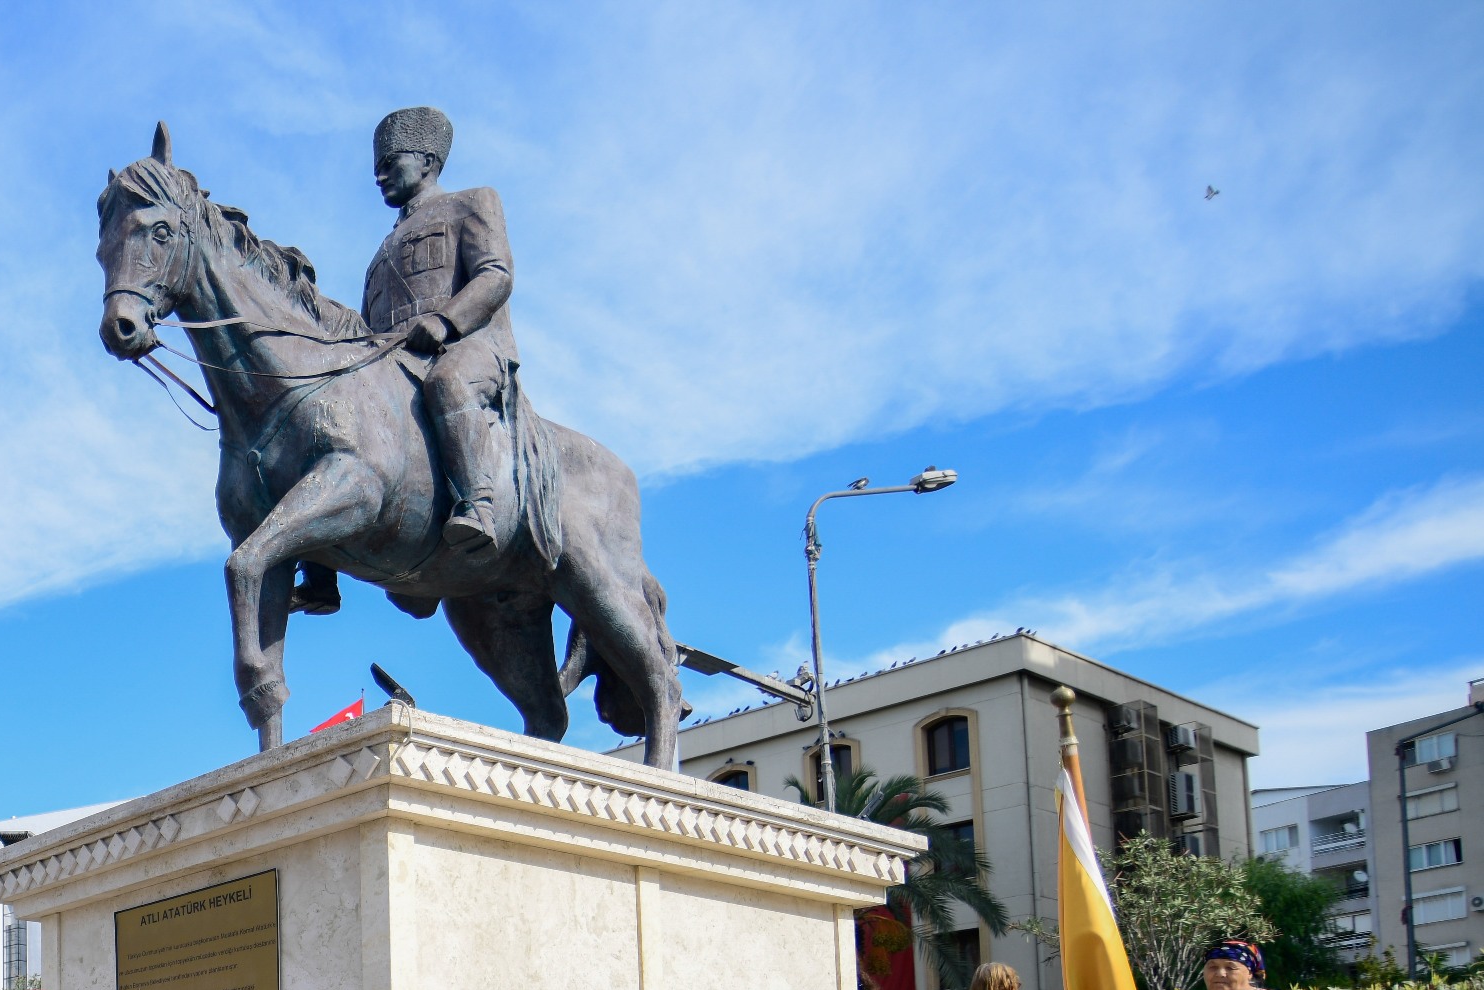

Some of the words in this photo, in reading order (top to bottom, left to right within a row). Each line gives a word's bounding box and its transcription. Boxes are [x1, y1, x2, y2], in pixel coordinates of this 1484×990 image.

[140, 911, 160, 926] ATLI
[162, 901, 207, 921] ATATÜRK
[209, 884, 252, 909] HEYKELİ
